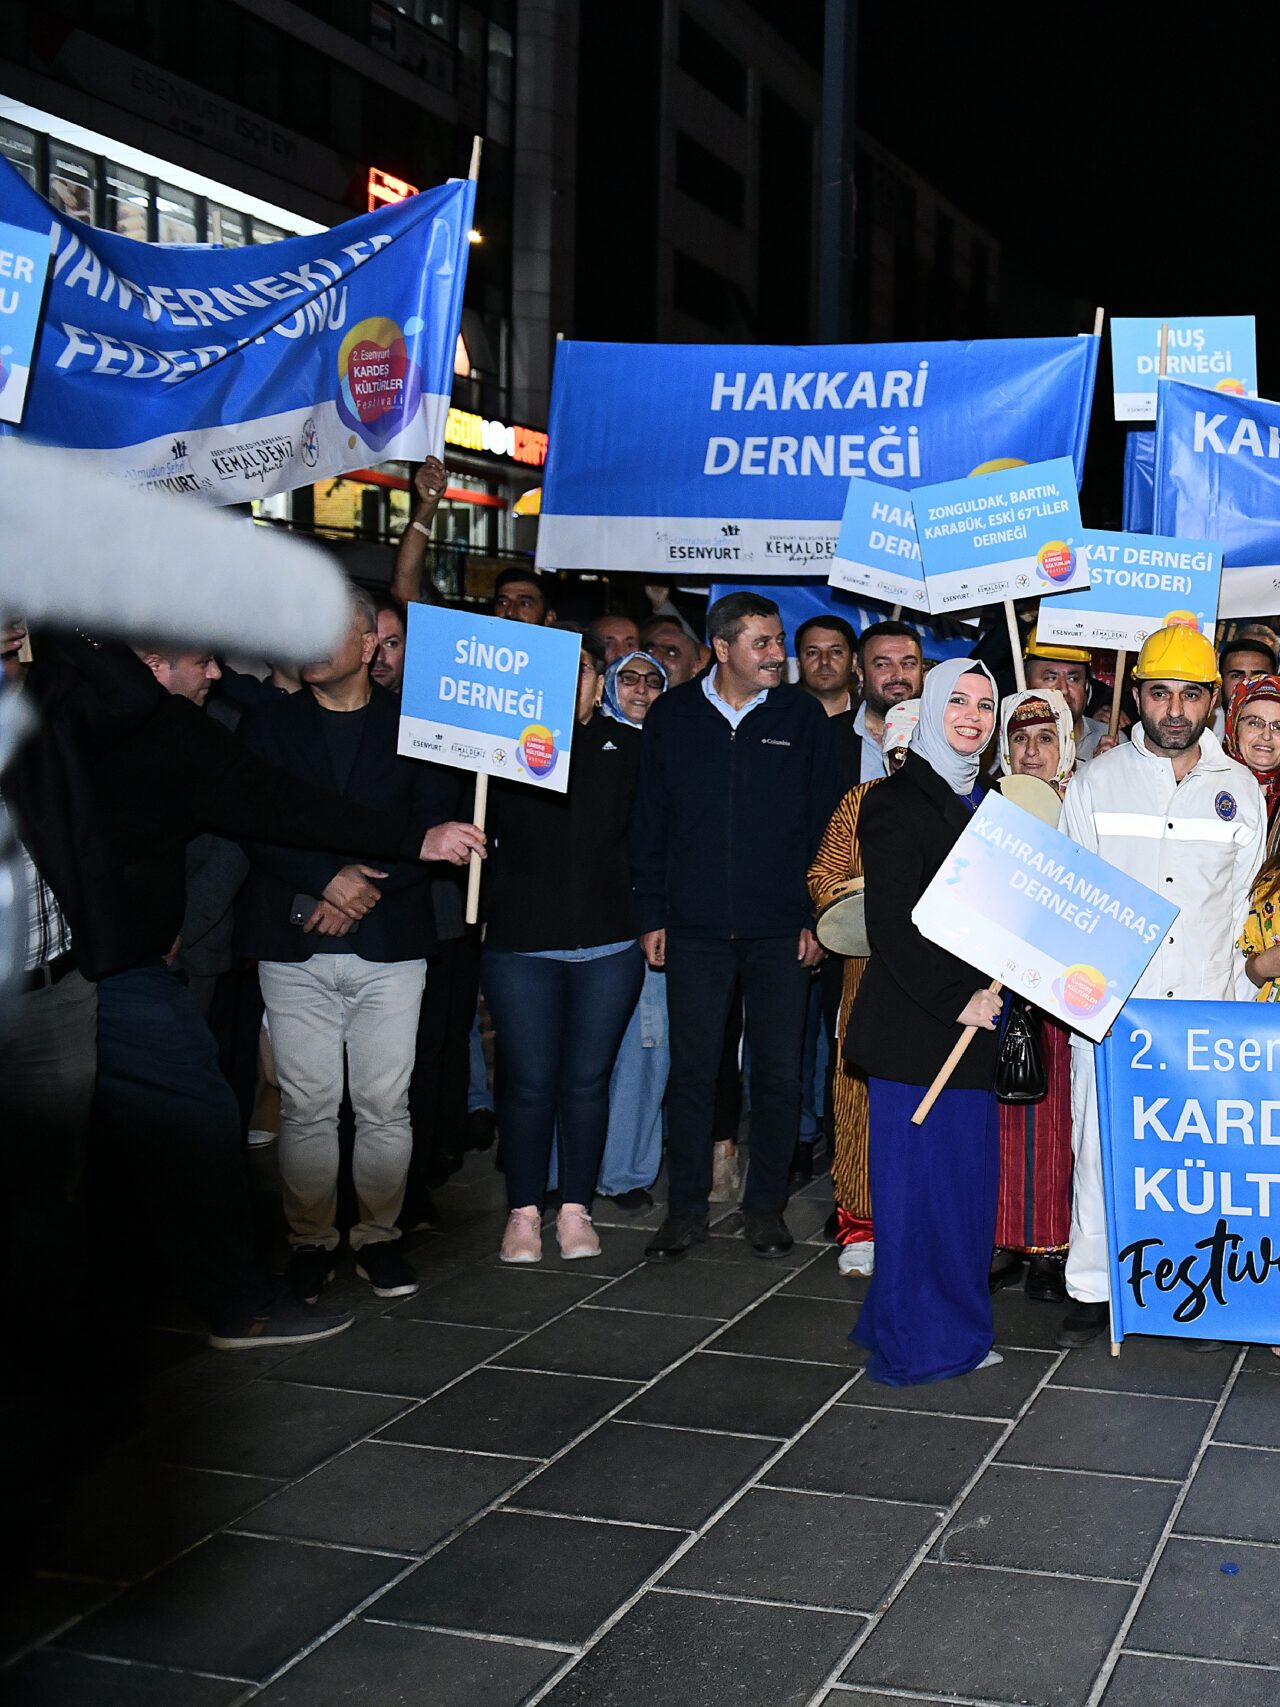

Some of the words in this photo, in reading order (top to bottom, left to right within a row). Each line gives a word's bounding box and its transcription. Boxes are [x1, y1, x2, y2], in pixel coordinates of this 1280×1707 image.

[1157, 329, 1205, 351] MUŞ
[353, 364, 389, 378] KARDEŞ
[355, 379, 403, 395] KÜLTÜRLER
[709, 361, 930, 411] HAKKARİ
[703, 425, 921, 478] DERNEĞİ
[924, 518, 988, 540] KARABÜK,
[989, 508, 1015, 526] ESKİ
[1017, 500, 1070, 520] 67'LİLER
[928, 494, 1009, 520] ZONGULDAK,
[1011, 484, 1060, 505] BARTIN,
[669, 546, 740, 560] ESENYURT
[973, 527, 1027, 549] DERNEĞİ
[1123, 546, 1213, 572] DERNEĞİ
[454, 635, 530, 675] SİNOP
[439, 676, 544, 720] DERNEĞİ
[413, 739, 443, 752] ESENYURT
[975, 816, 1160, 944] KAHRAMANMARAŞ
[1009, 870, 1100, 935] DERNEĞİ
[1129, 1029, 1166, 1071] 2.
